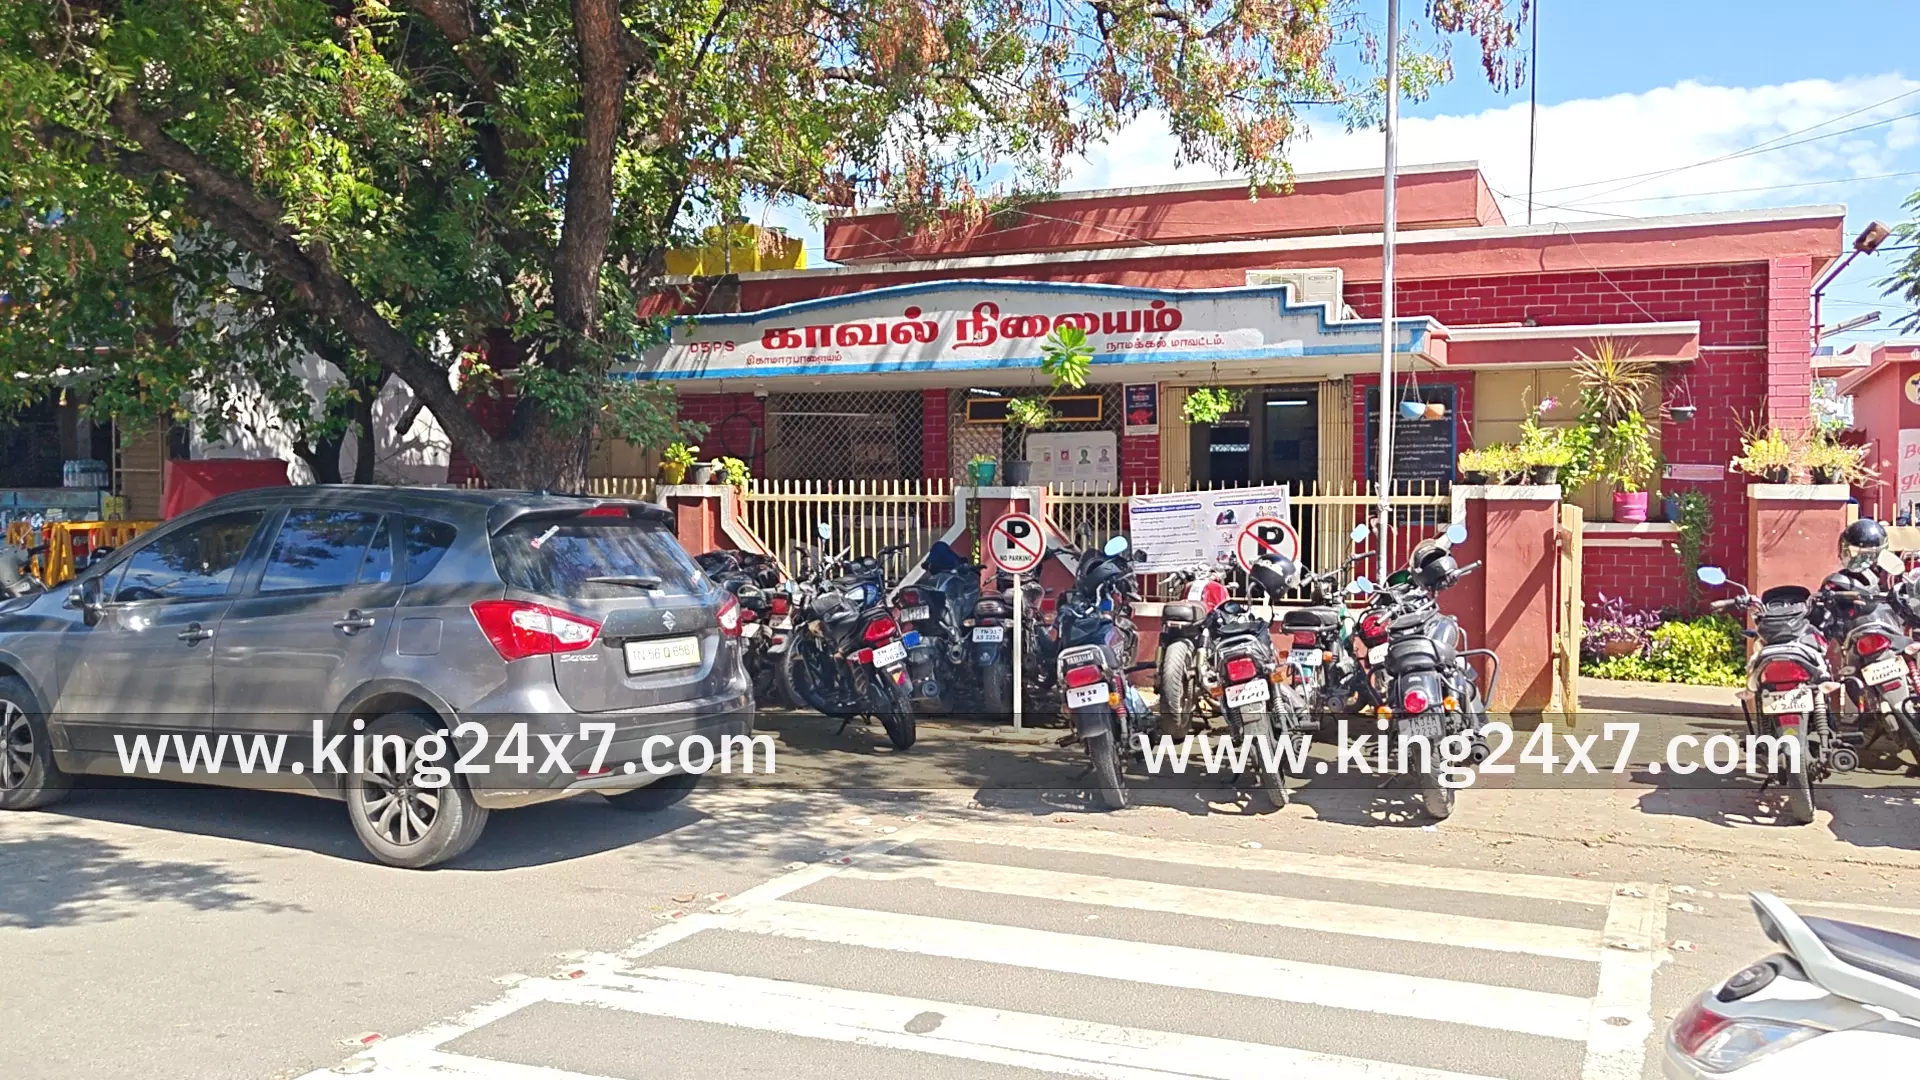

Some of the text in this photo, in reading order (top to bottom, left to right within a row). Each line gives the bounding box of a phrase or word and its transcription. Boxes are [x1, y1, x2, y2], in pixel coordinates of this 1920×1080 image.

[761, 299, 1183, 350] காவல் நிலையம்
[1106, 336, 1167, 353] நாமக்கல்
[1904, 443, 1920, 459] B
[1007, 520, 1031, 549] P
[1258, 526, 1285, 556] P
[1008, 554, 1033, 562] PARKING
[632, 649, 646, 661] TN
[1066, 652, 1095, 665] YAMAHA
